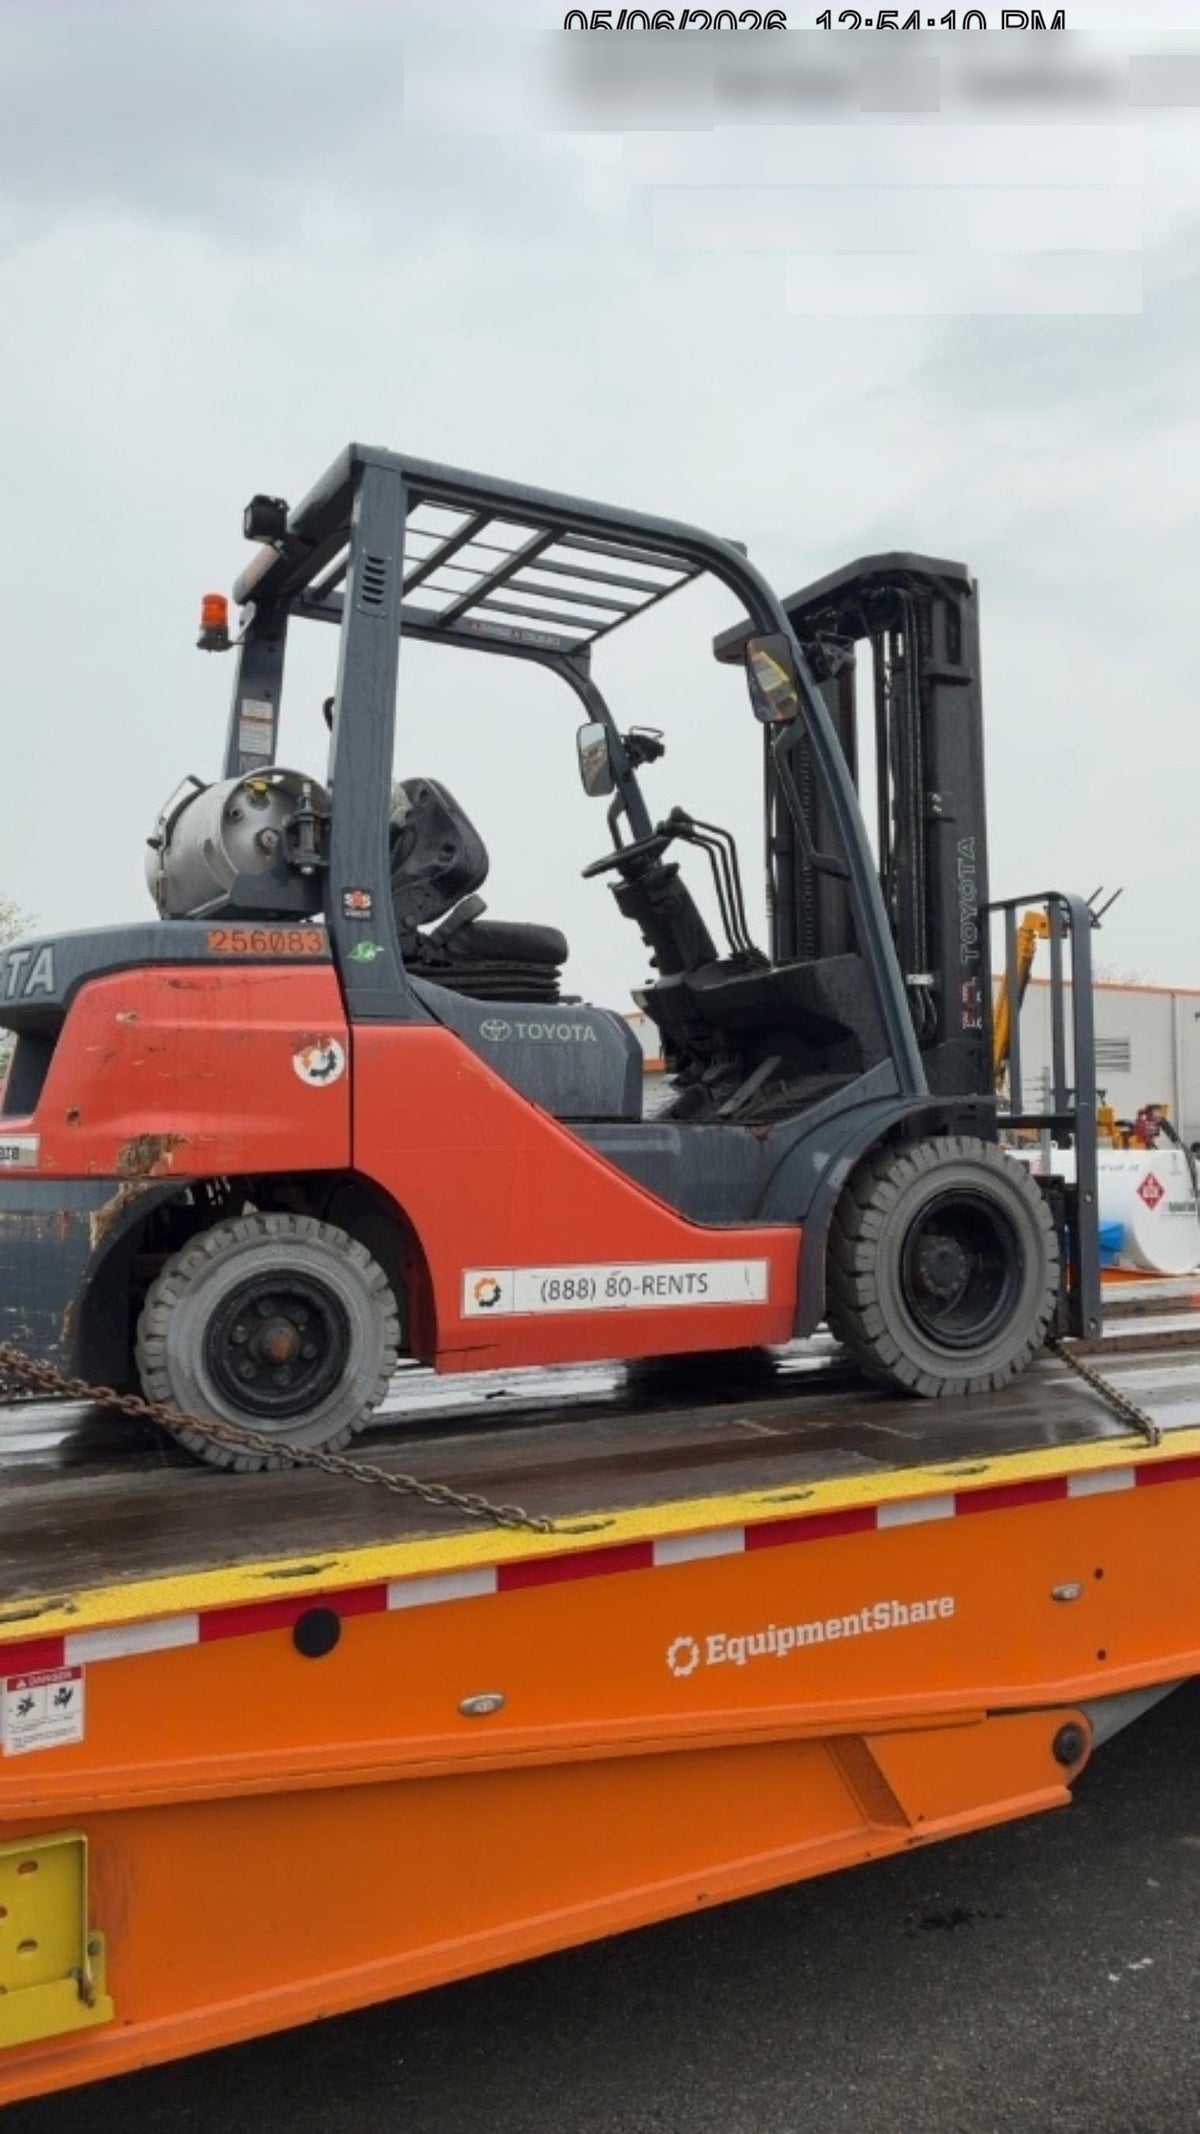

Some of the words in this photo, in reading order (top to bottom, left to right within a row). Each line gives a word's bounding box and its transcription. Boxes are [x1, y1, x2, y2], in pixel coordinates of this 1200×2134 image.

[957, 837, 979, 965] TOYOTA
[210, 930, 322, 953] 256083
[515, 1023, 598, 1042] TOYOTA
[540, 1278, 596, 1303] (888)
[605, 1272, 708, 1299] 80-RENTS
[705, 1596, 955, 1666] EquipmentShare
